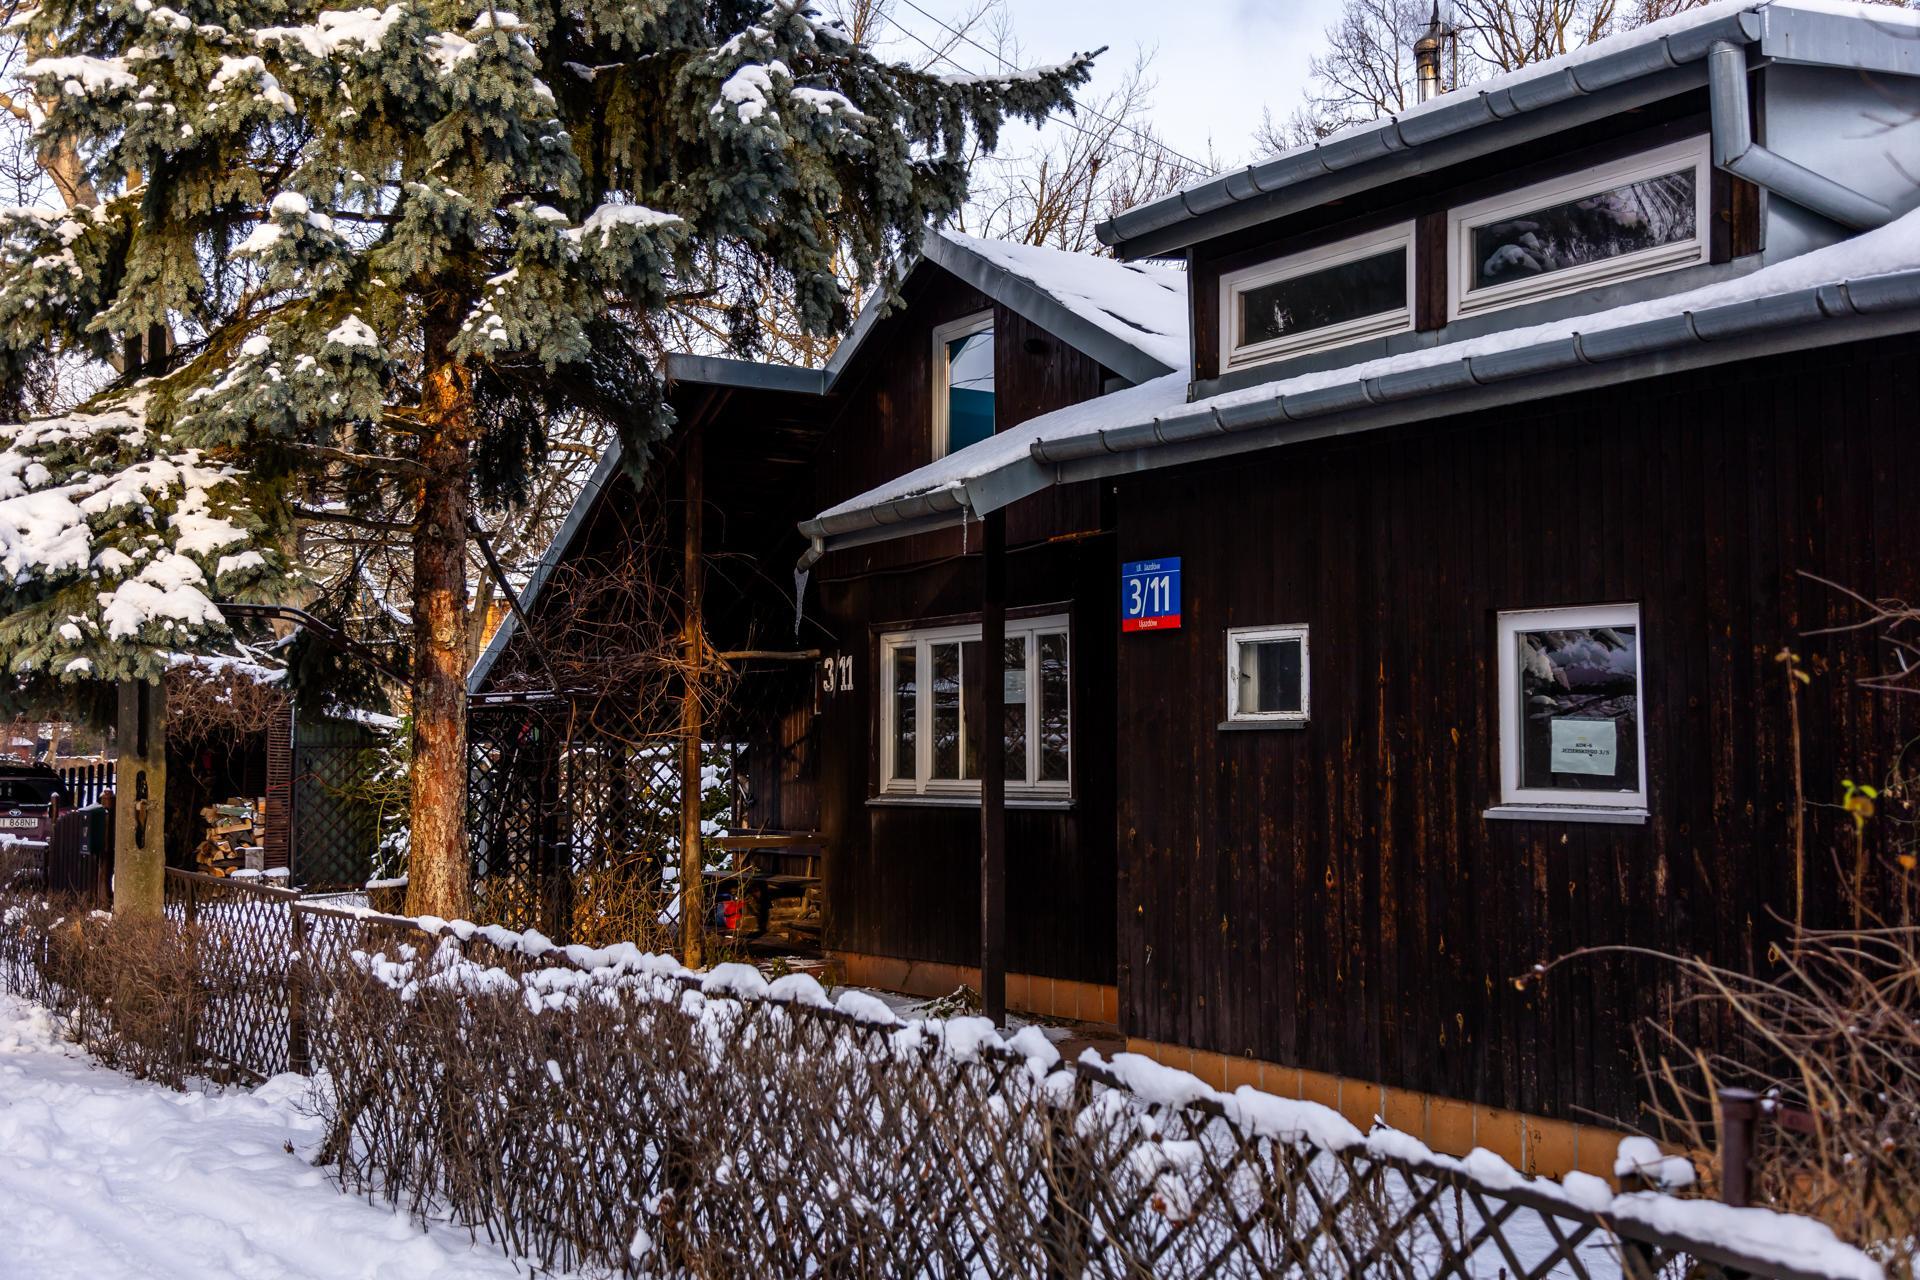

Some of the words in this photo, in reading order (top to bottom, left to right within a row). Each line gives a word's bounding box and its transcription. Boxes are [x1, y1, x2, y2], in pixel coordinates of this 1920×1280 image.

[1129, 575, 1170, 618] 3/11
[823, 650, 854, 698] 3/11
[10, 818, 36, 827] 868NH
